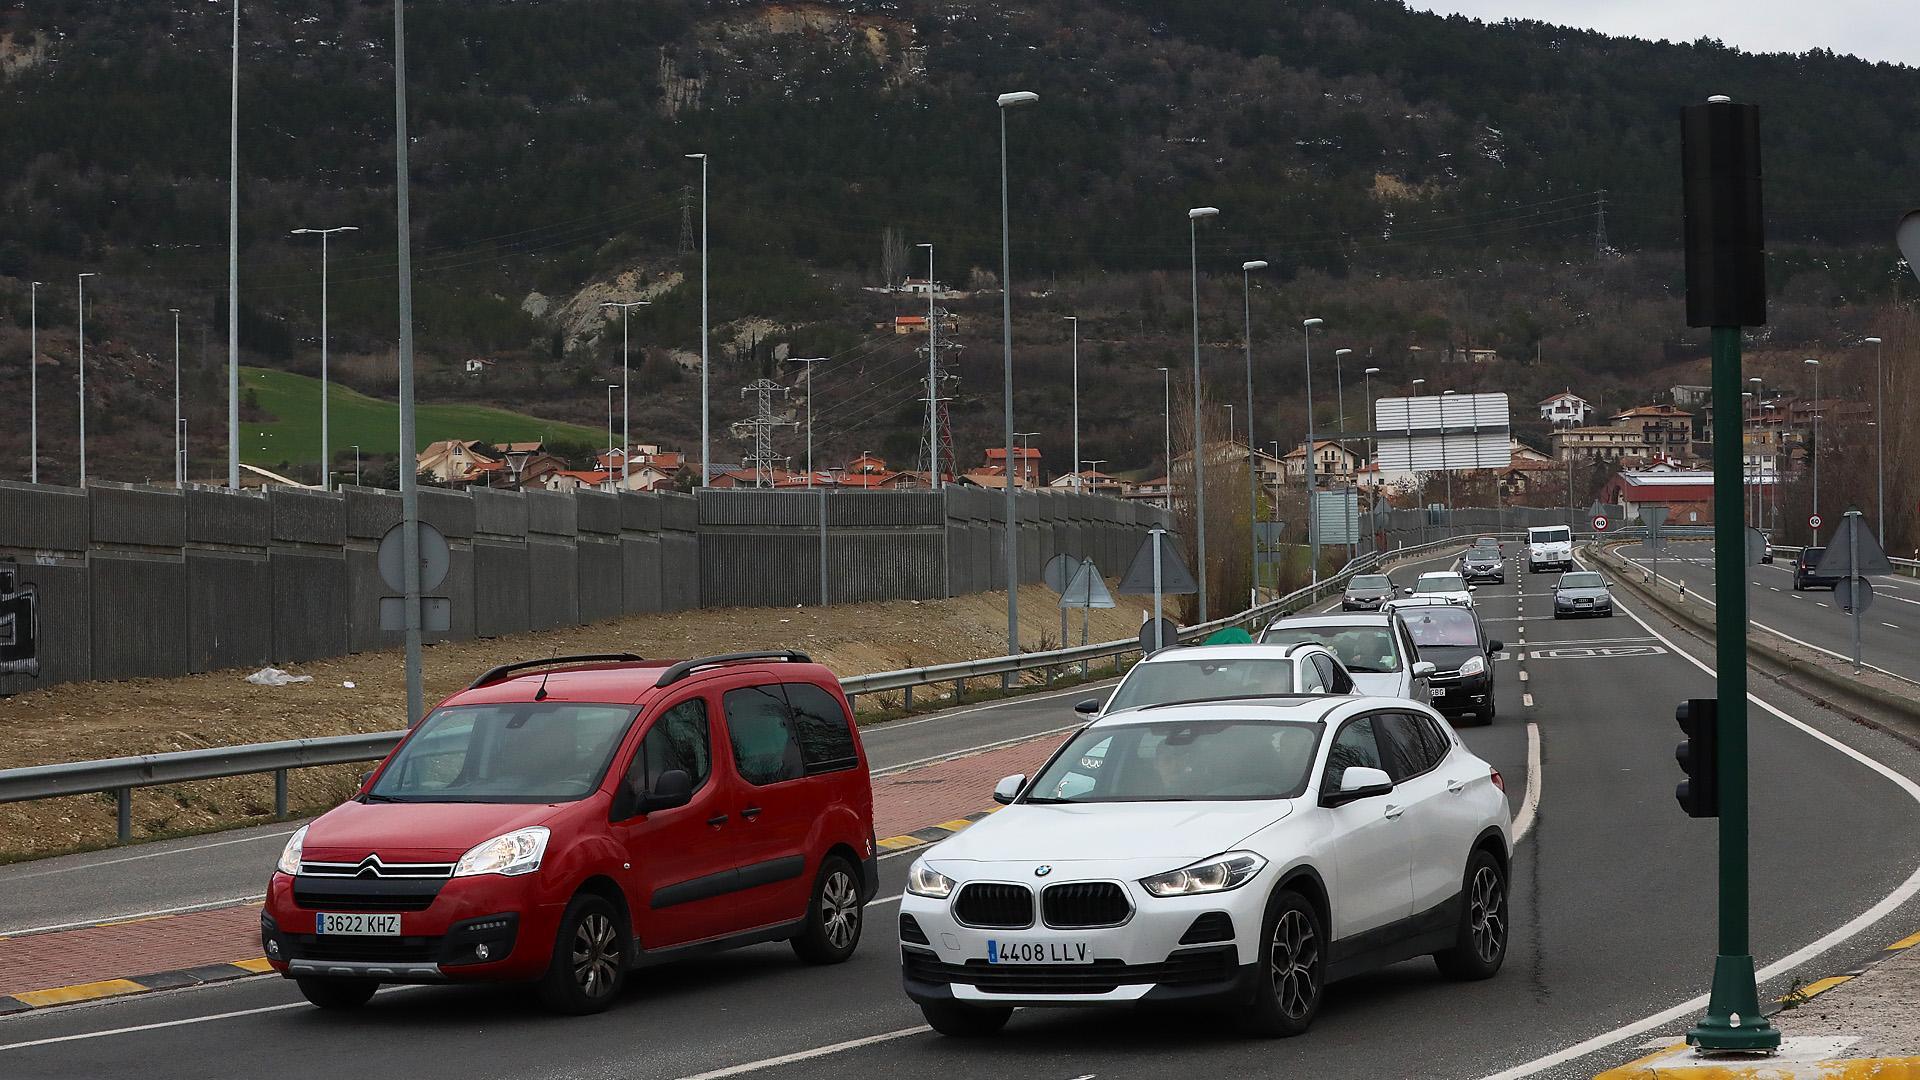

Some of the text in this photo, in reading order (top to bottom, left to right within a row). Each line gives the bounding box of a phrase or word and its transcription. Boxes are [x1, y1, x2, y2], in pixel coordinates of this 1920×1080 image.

[327, 915, 396, 933] 3622 KHZ
[1000, 943, 1086, 961] 4408 LLV
